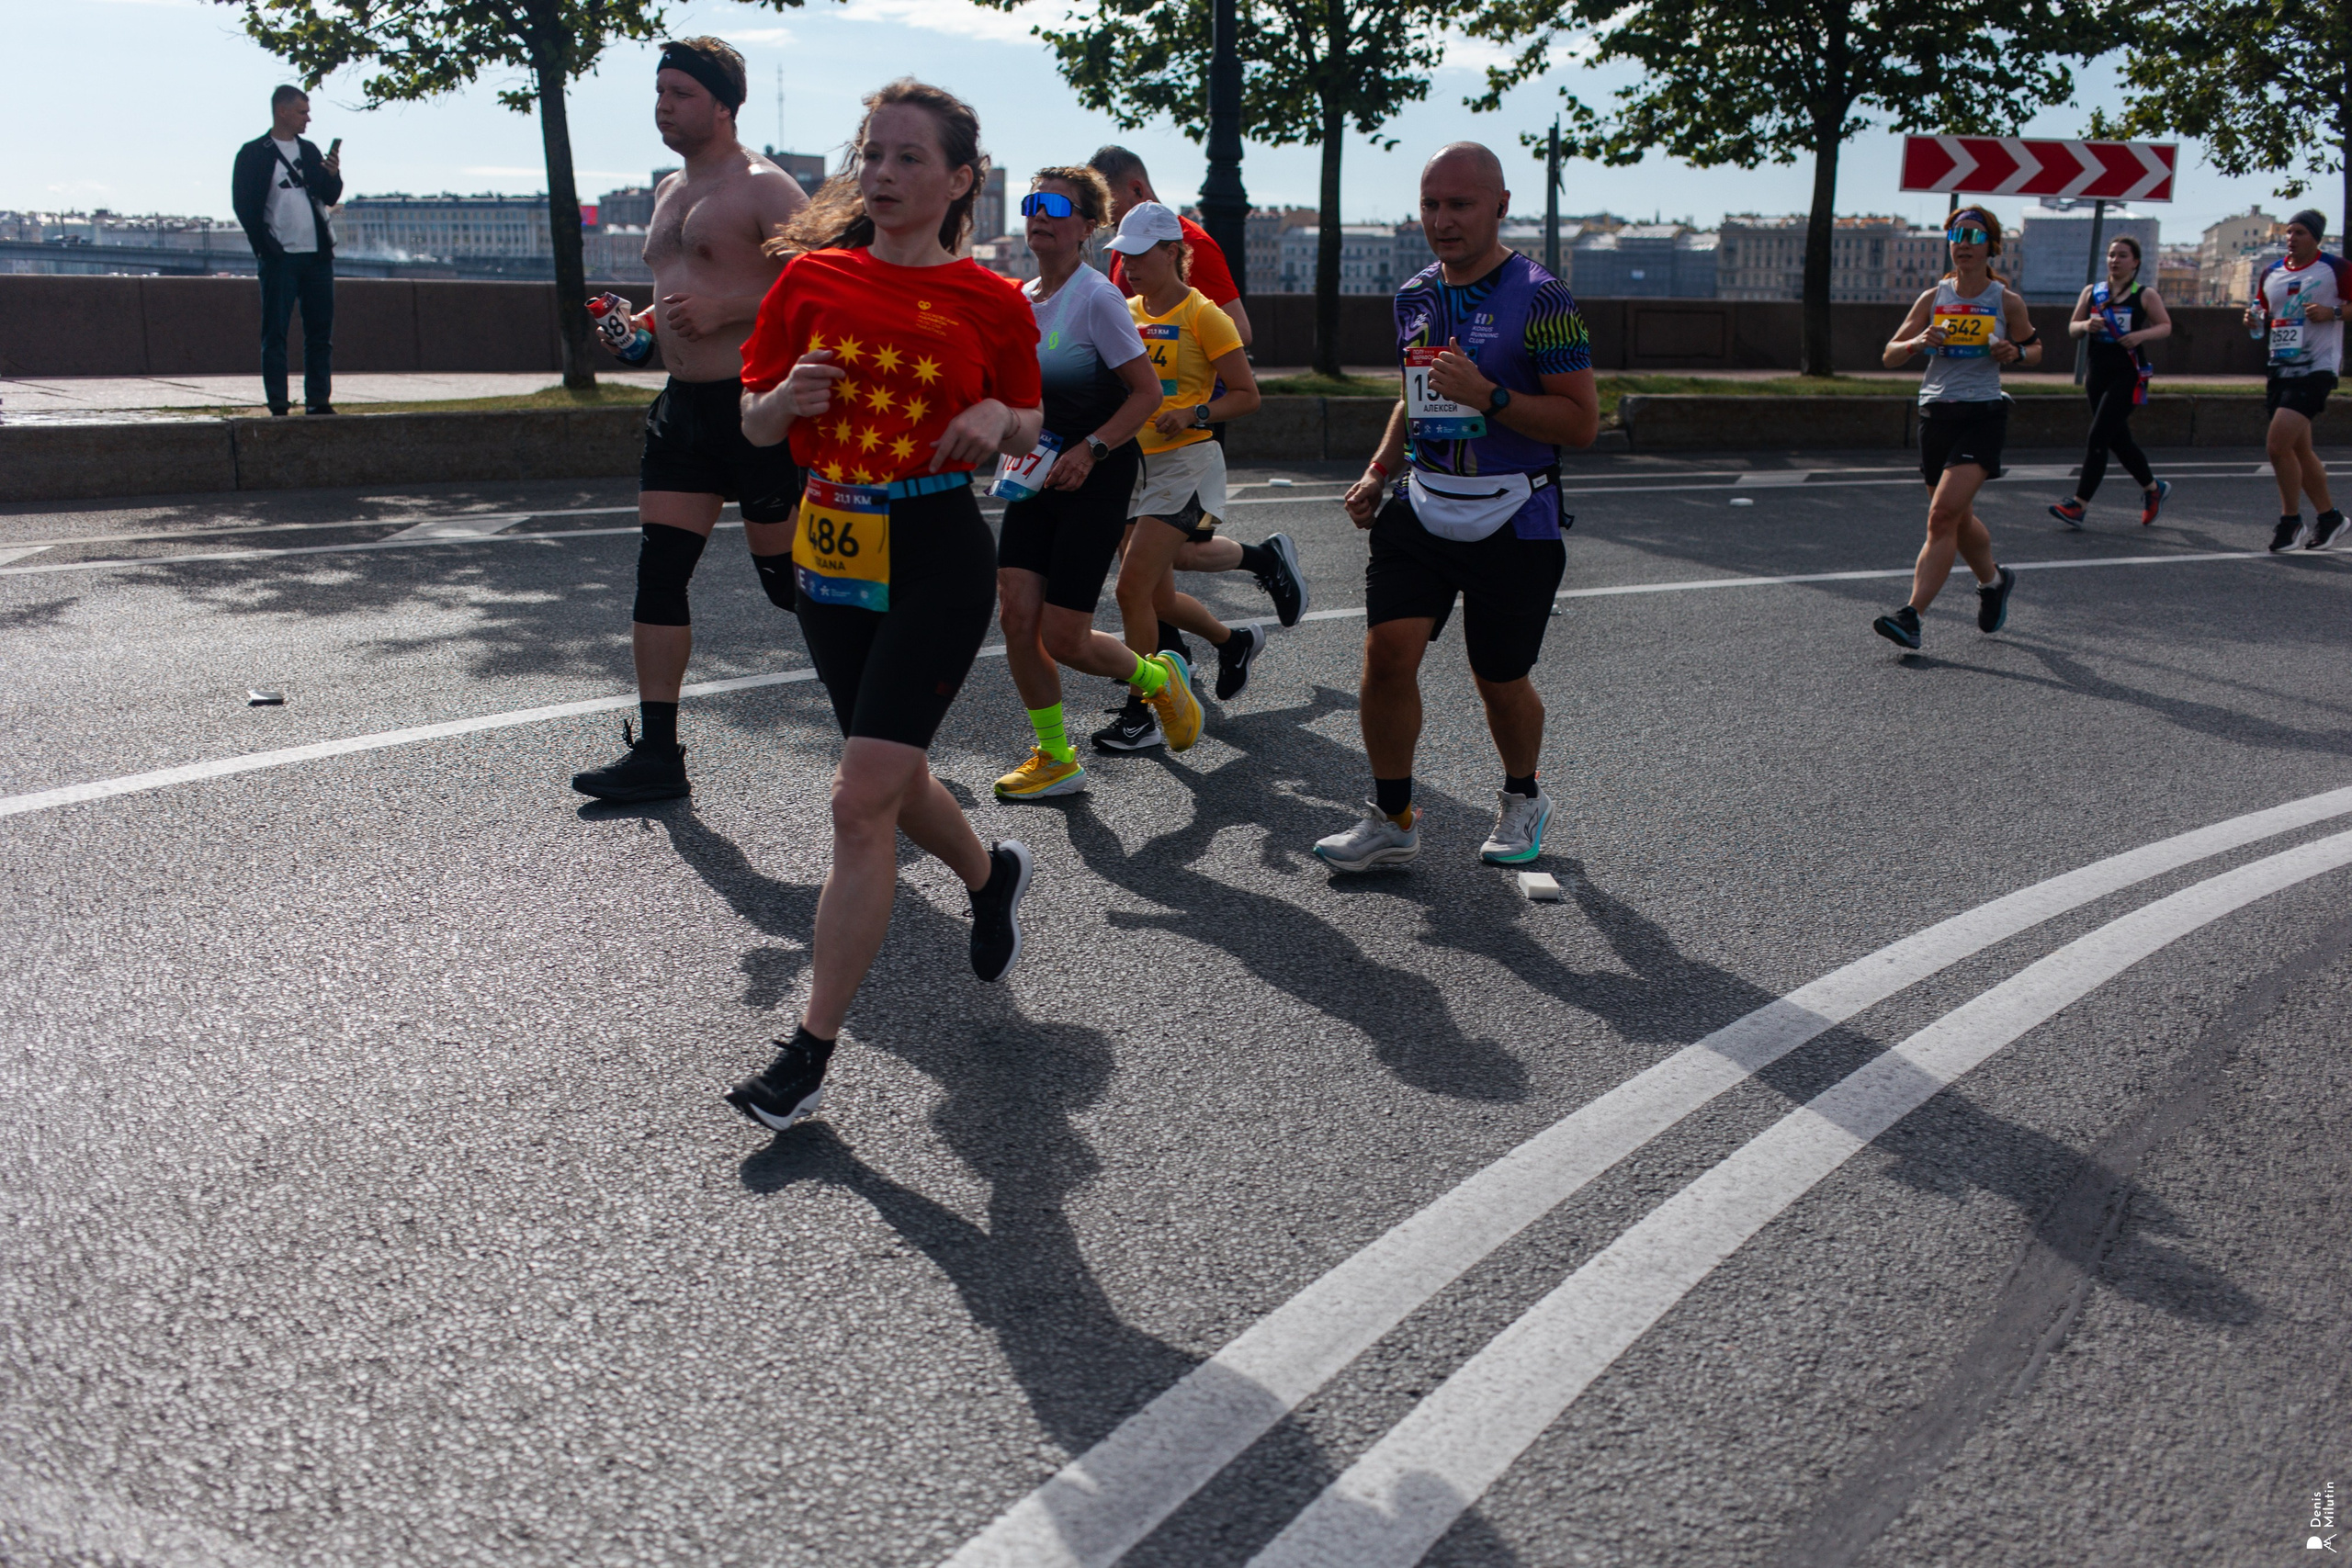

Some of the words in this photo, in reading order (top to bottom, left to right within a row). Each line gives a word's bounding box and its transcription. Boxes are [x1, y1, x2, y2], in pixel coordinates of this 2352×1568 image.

[1947, 319, 1982, 336] 542
[1423, 403, 1458, 412] АЛЕКСЕЙ
[808, 513, 860, 558] 486
